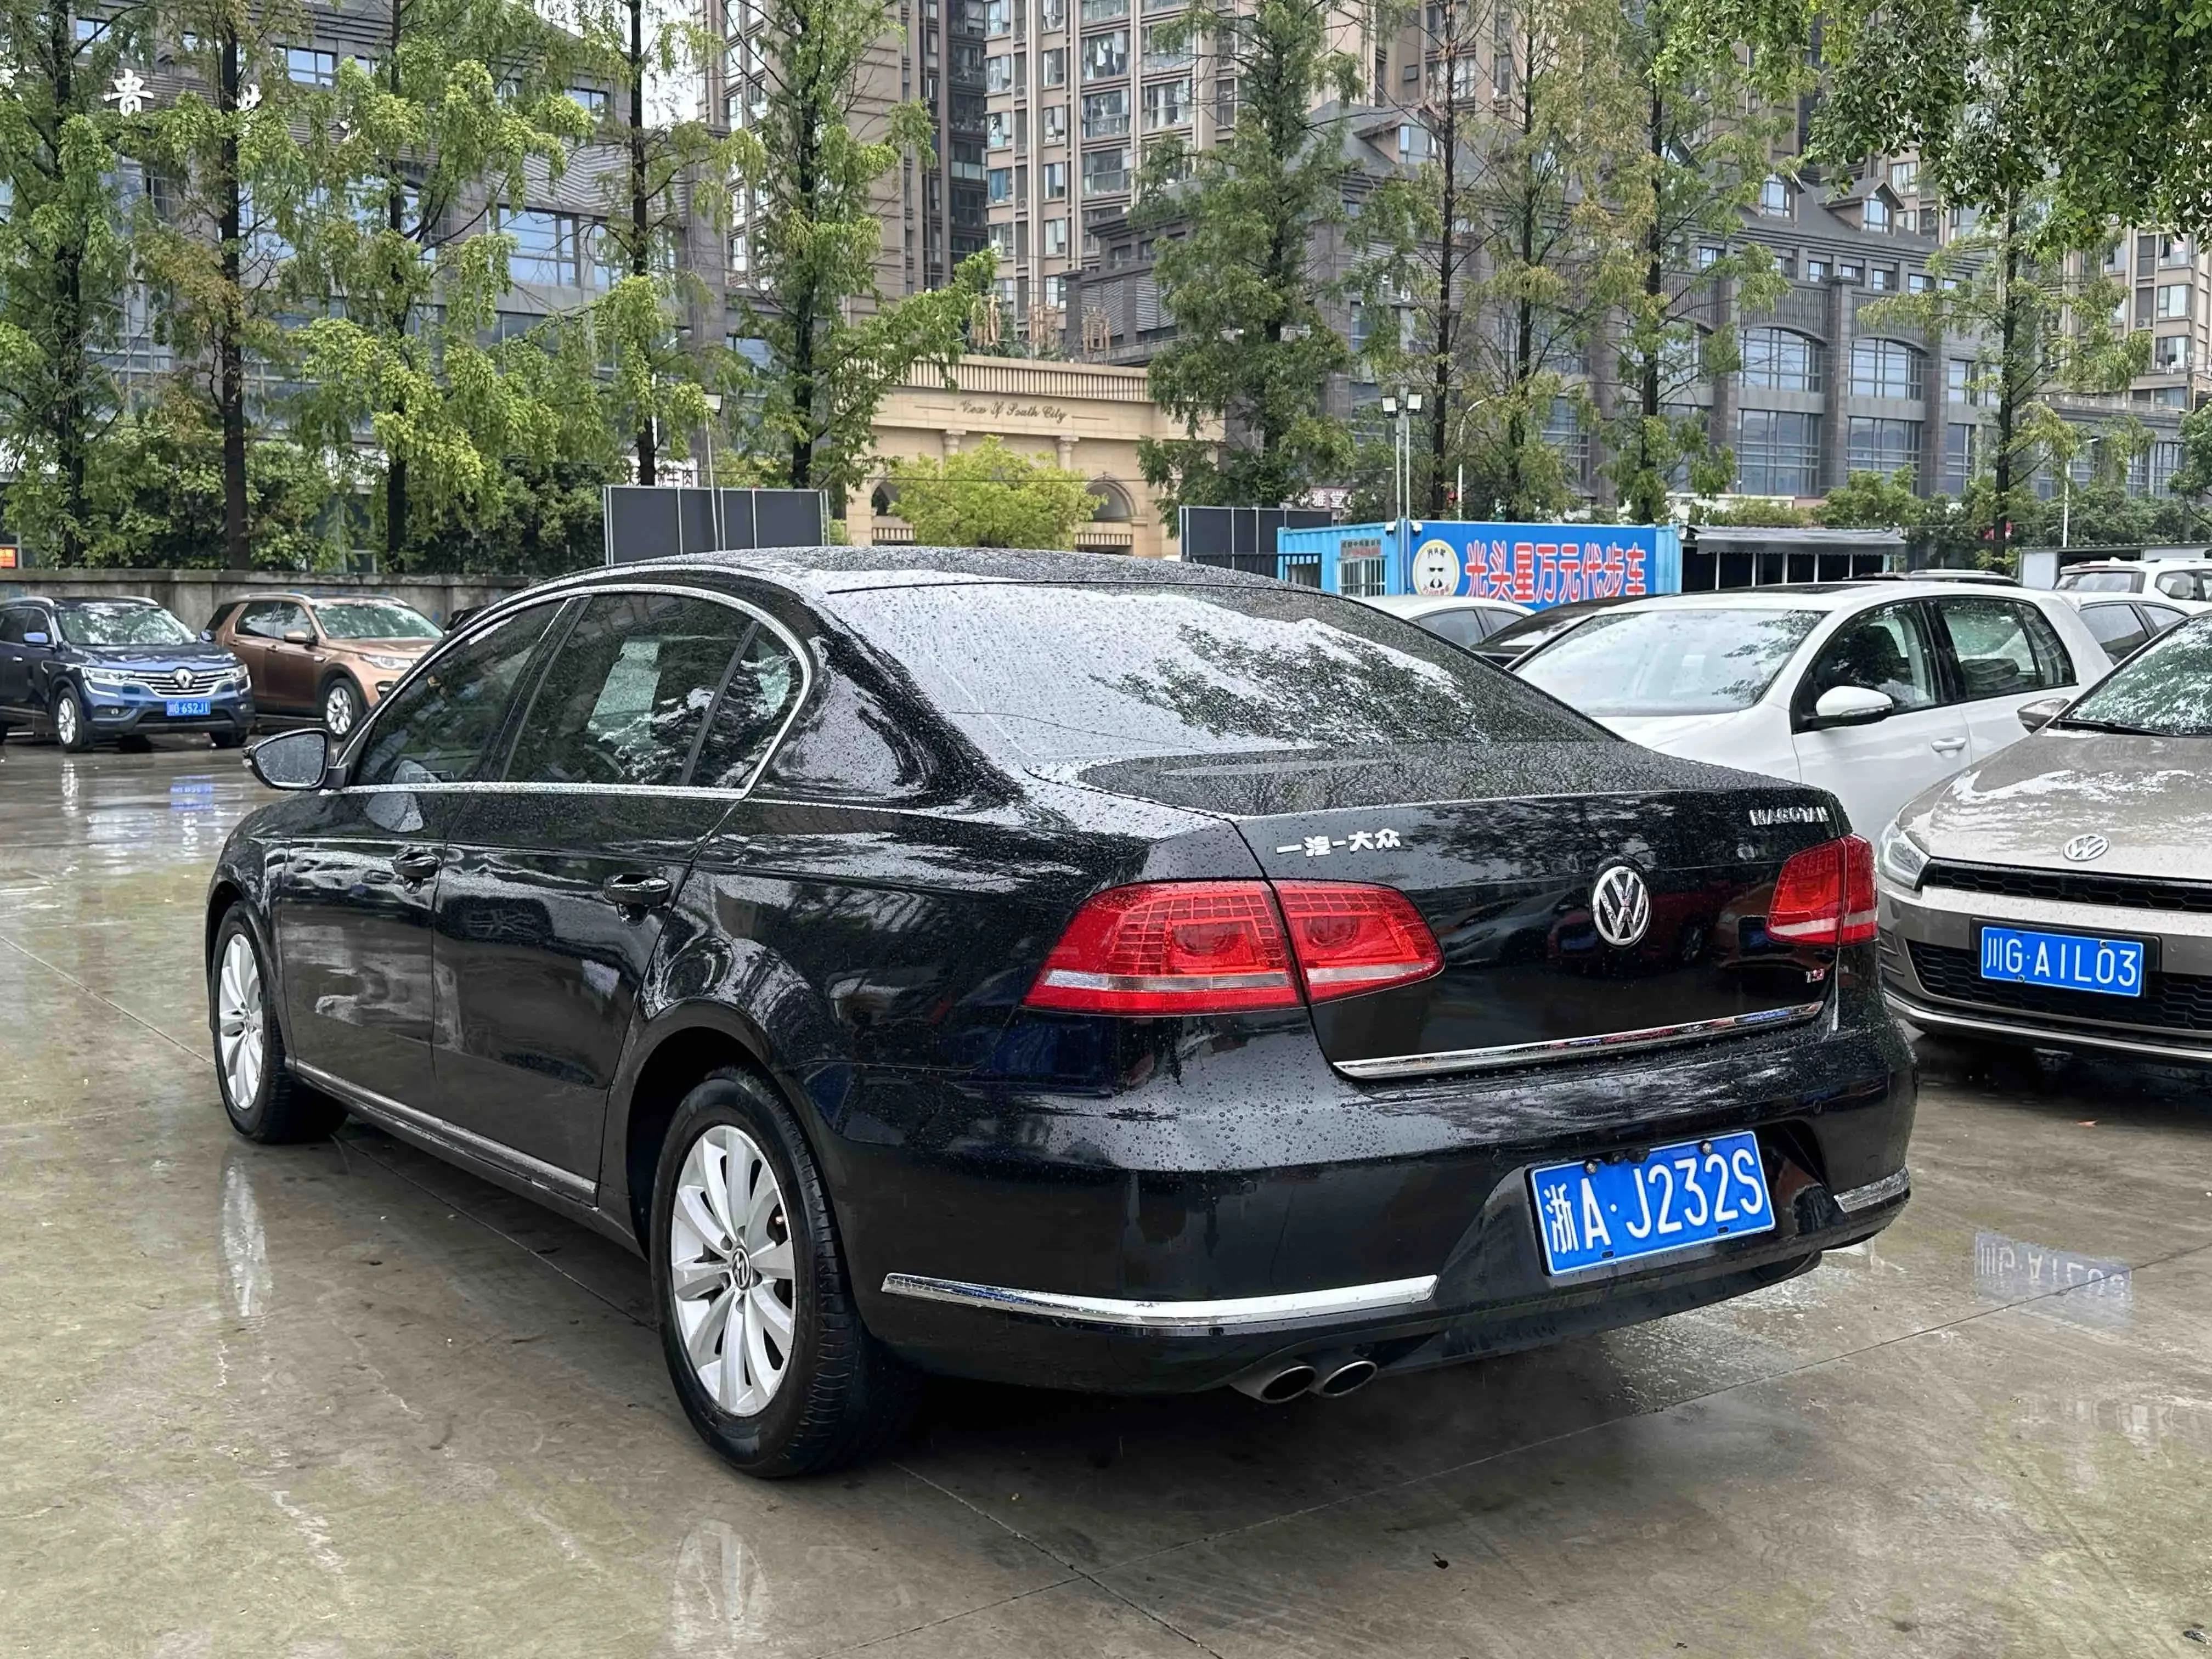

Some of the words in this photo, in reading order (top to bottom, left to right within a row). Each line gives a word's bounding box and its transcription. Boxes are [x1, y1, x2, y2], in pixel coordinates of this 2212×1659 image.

[1006, 402, 1040, 417] South
[1042, 405, 1067, 424] City
[1465, 540, 1646, 603] 光头星万元代步车
[1276, 828, 1401, 857] 一汽-大众
